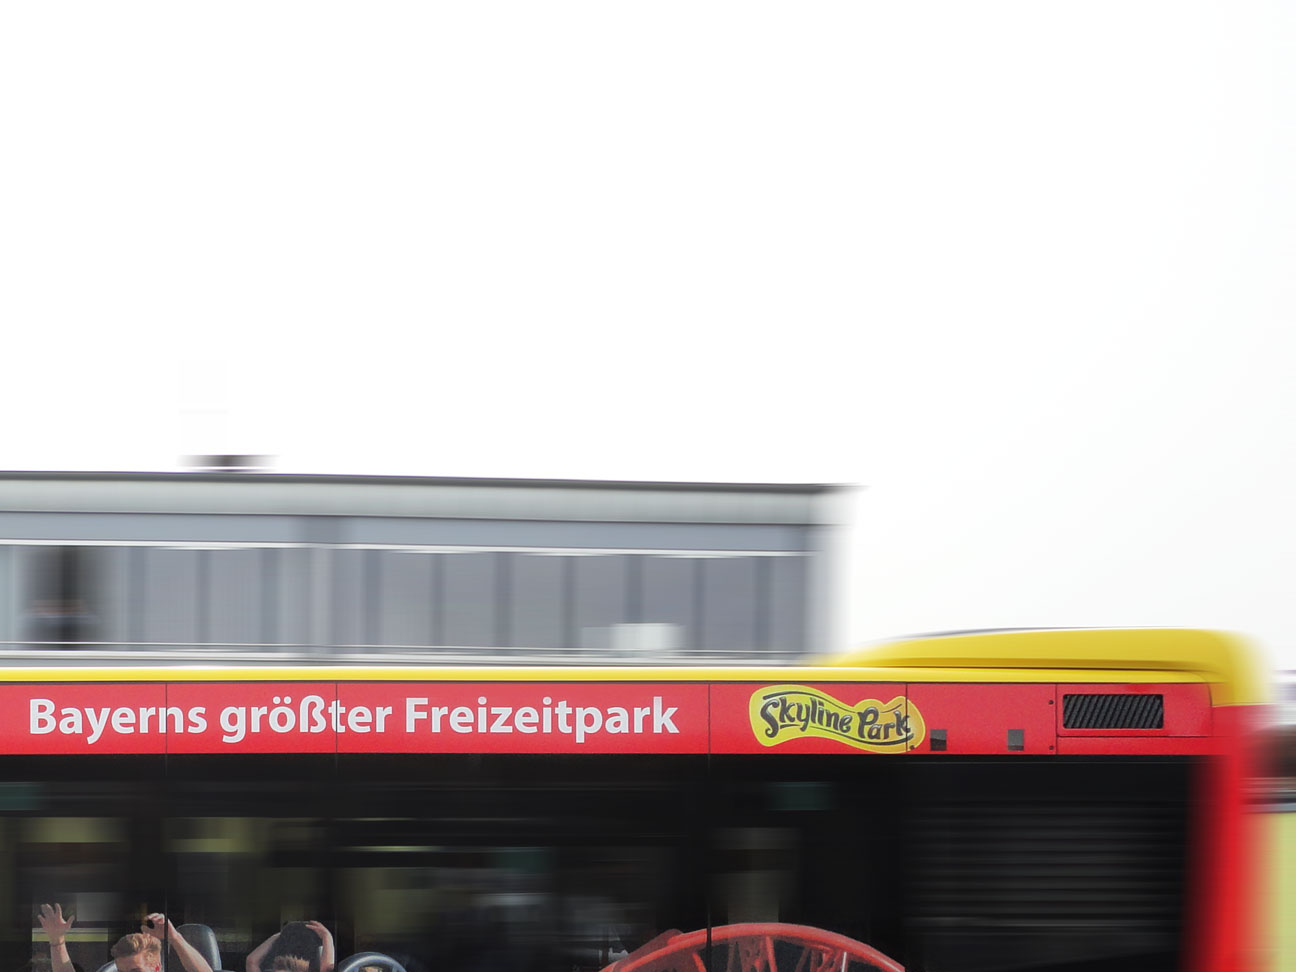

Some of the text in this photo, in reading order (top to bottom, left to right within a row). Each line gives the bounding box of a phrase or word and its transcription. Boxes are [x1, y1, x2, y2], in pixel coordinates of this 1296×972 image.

[29, 695, 680, 744] Bayerns größter Freizeitpark
[760, 697, 911, 741] Skyline Park
